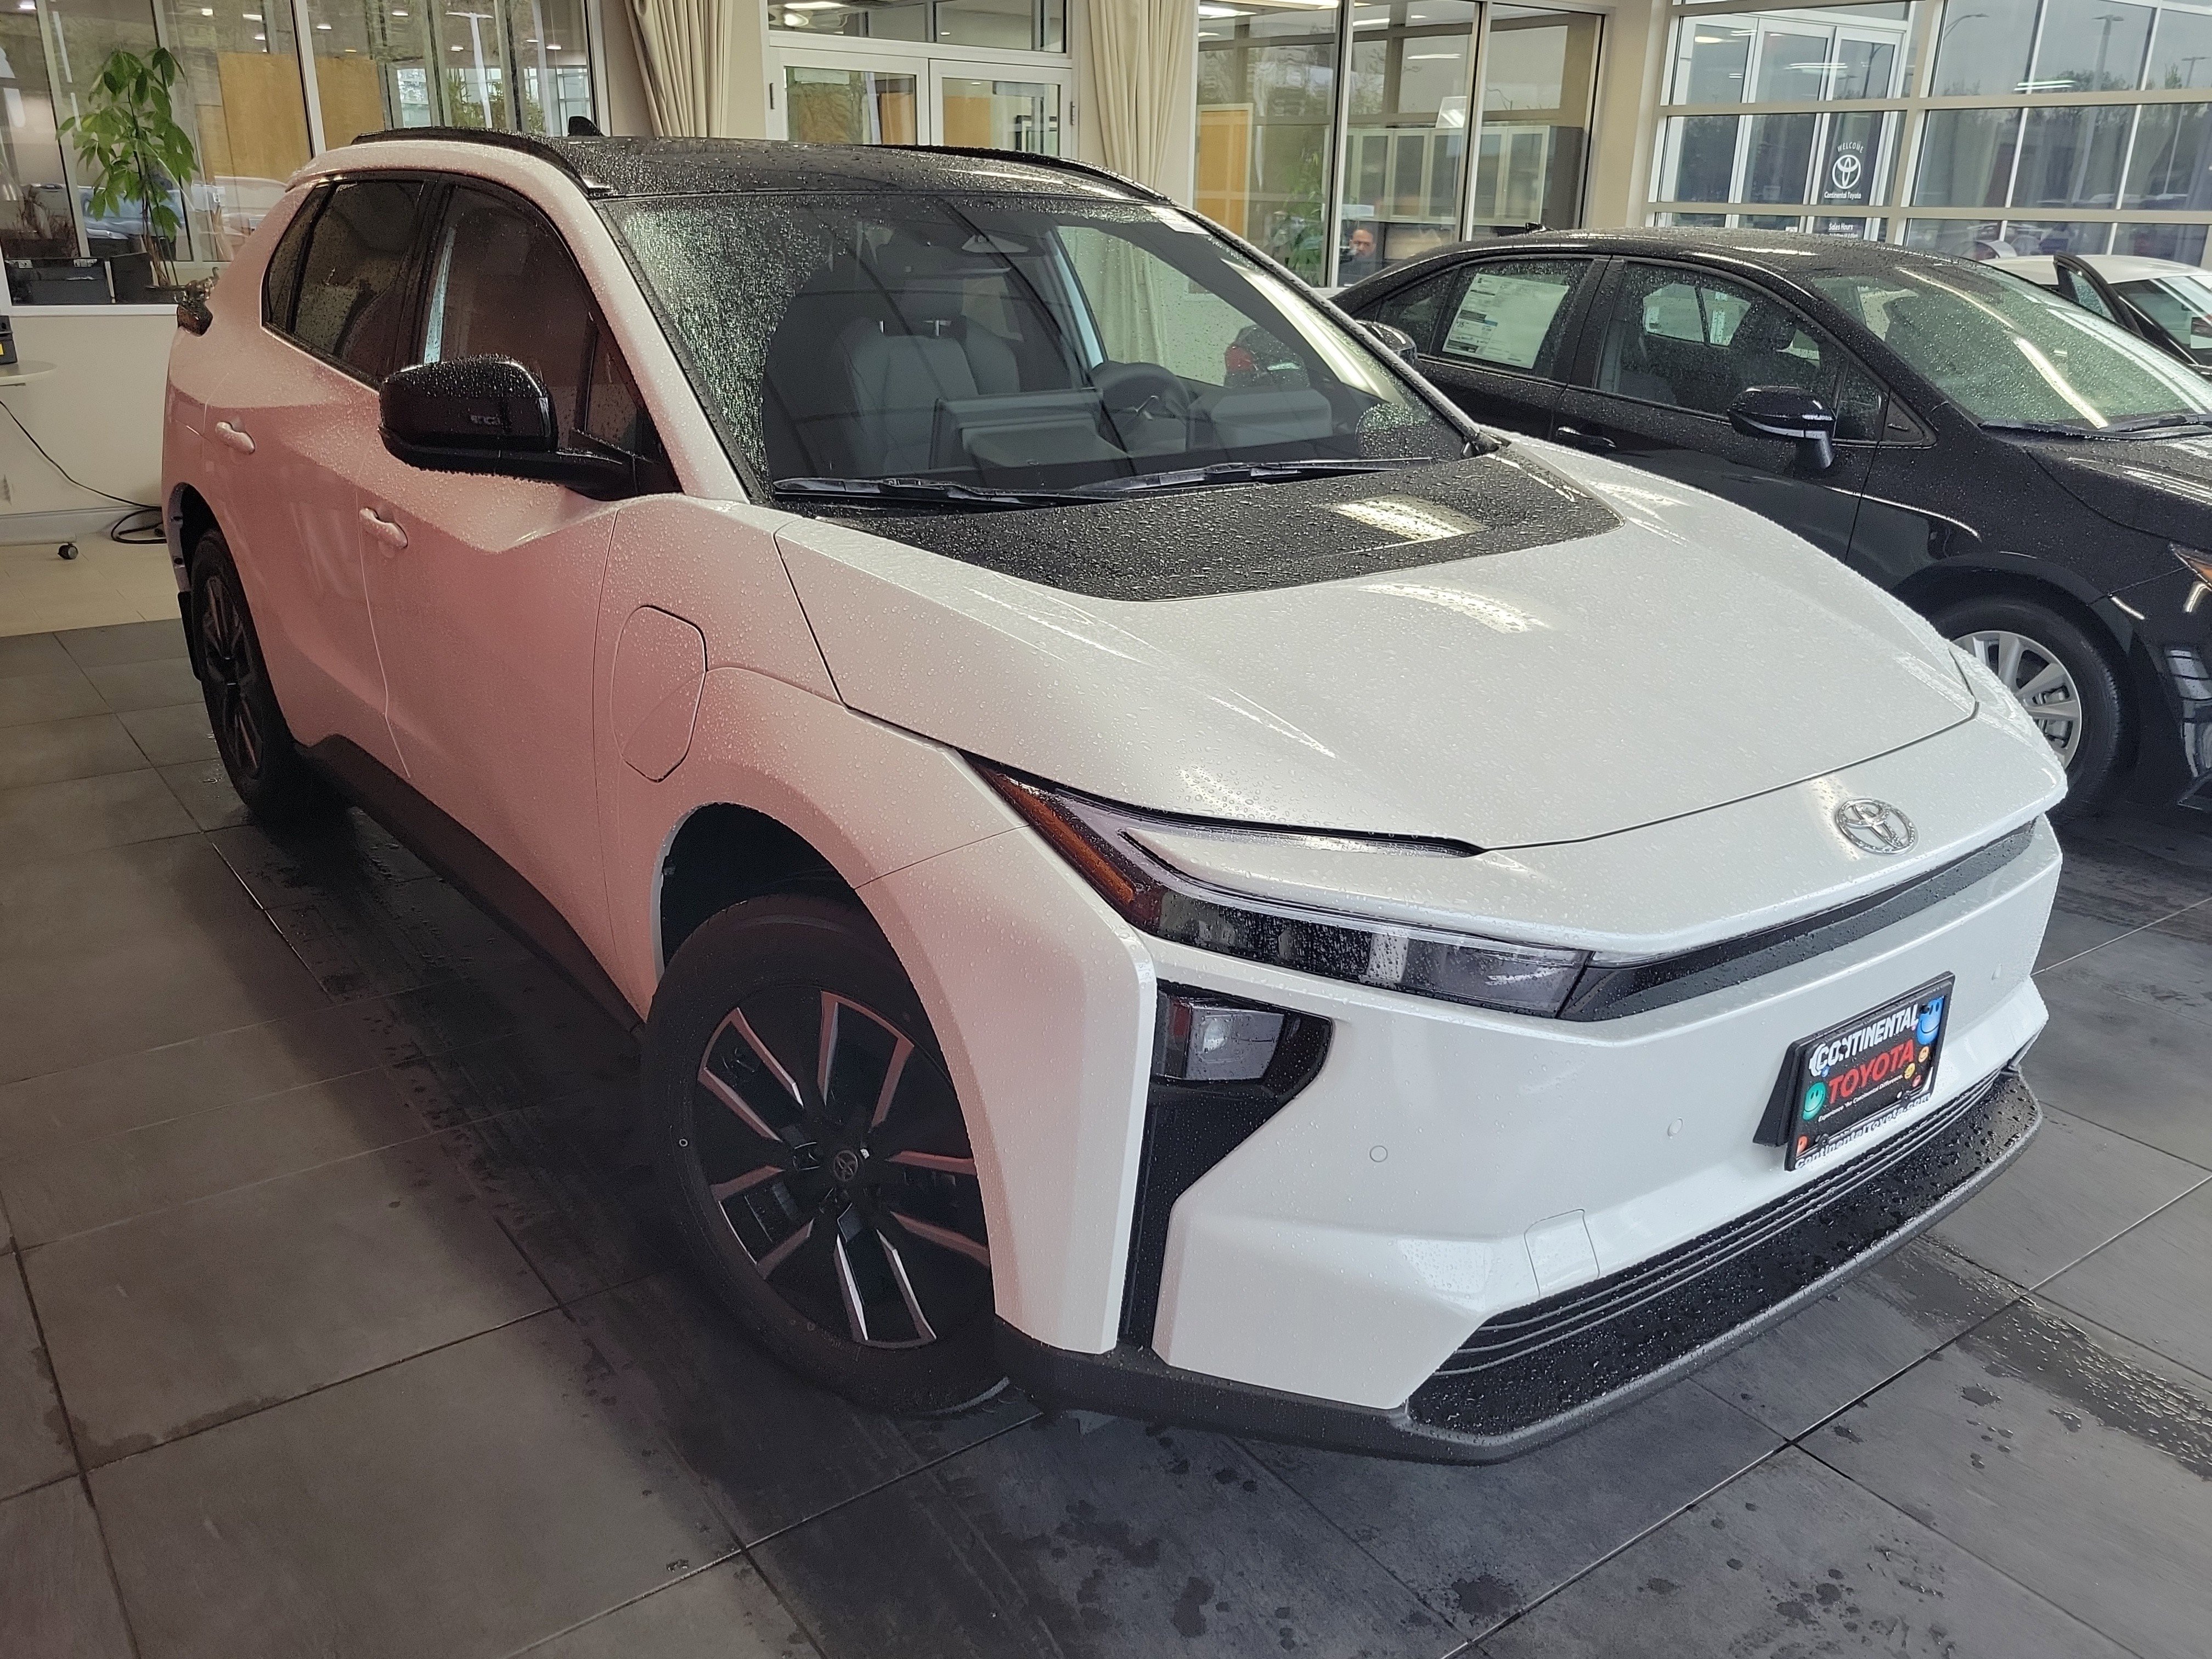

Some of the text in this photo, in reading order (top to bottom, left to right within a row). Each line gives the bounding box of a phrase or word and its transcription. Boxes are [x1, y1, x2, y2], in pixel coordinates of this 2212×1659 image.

[1837, 142, 1864, 153] WELCOME
[1847, 191, 1861, 200] Toyota
[1829, 222, 1853, 230] Sales Hours
[1829, 1039, 1914, 1104] TOYOTA
[1795, 1093, 1931, 1170] ContinentalToyota.com
